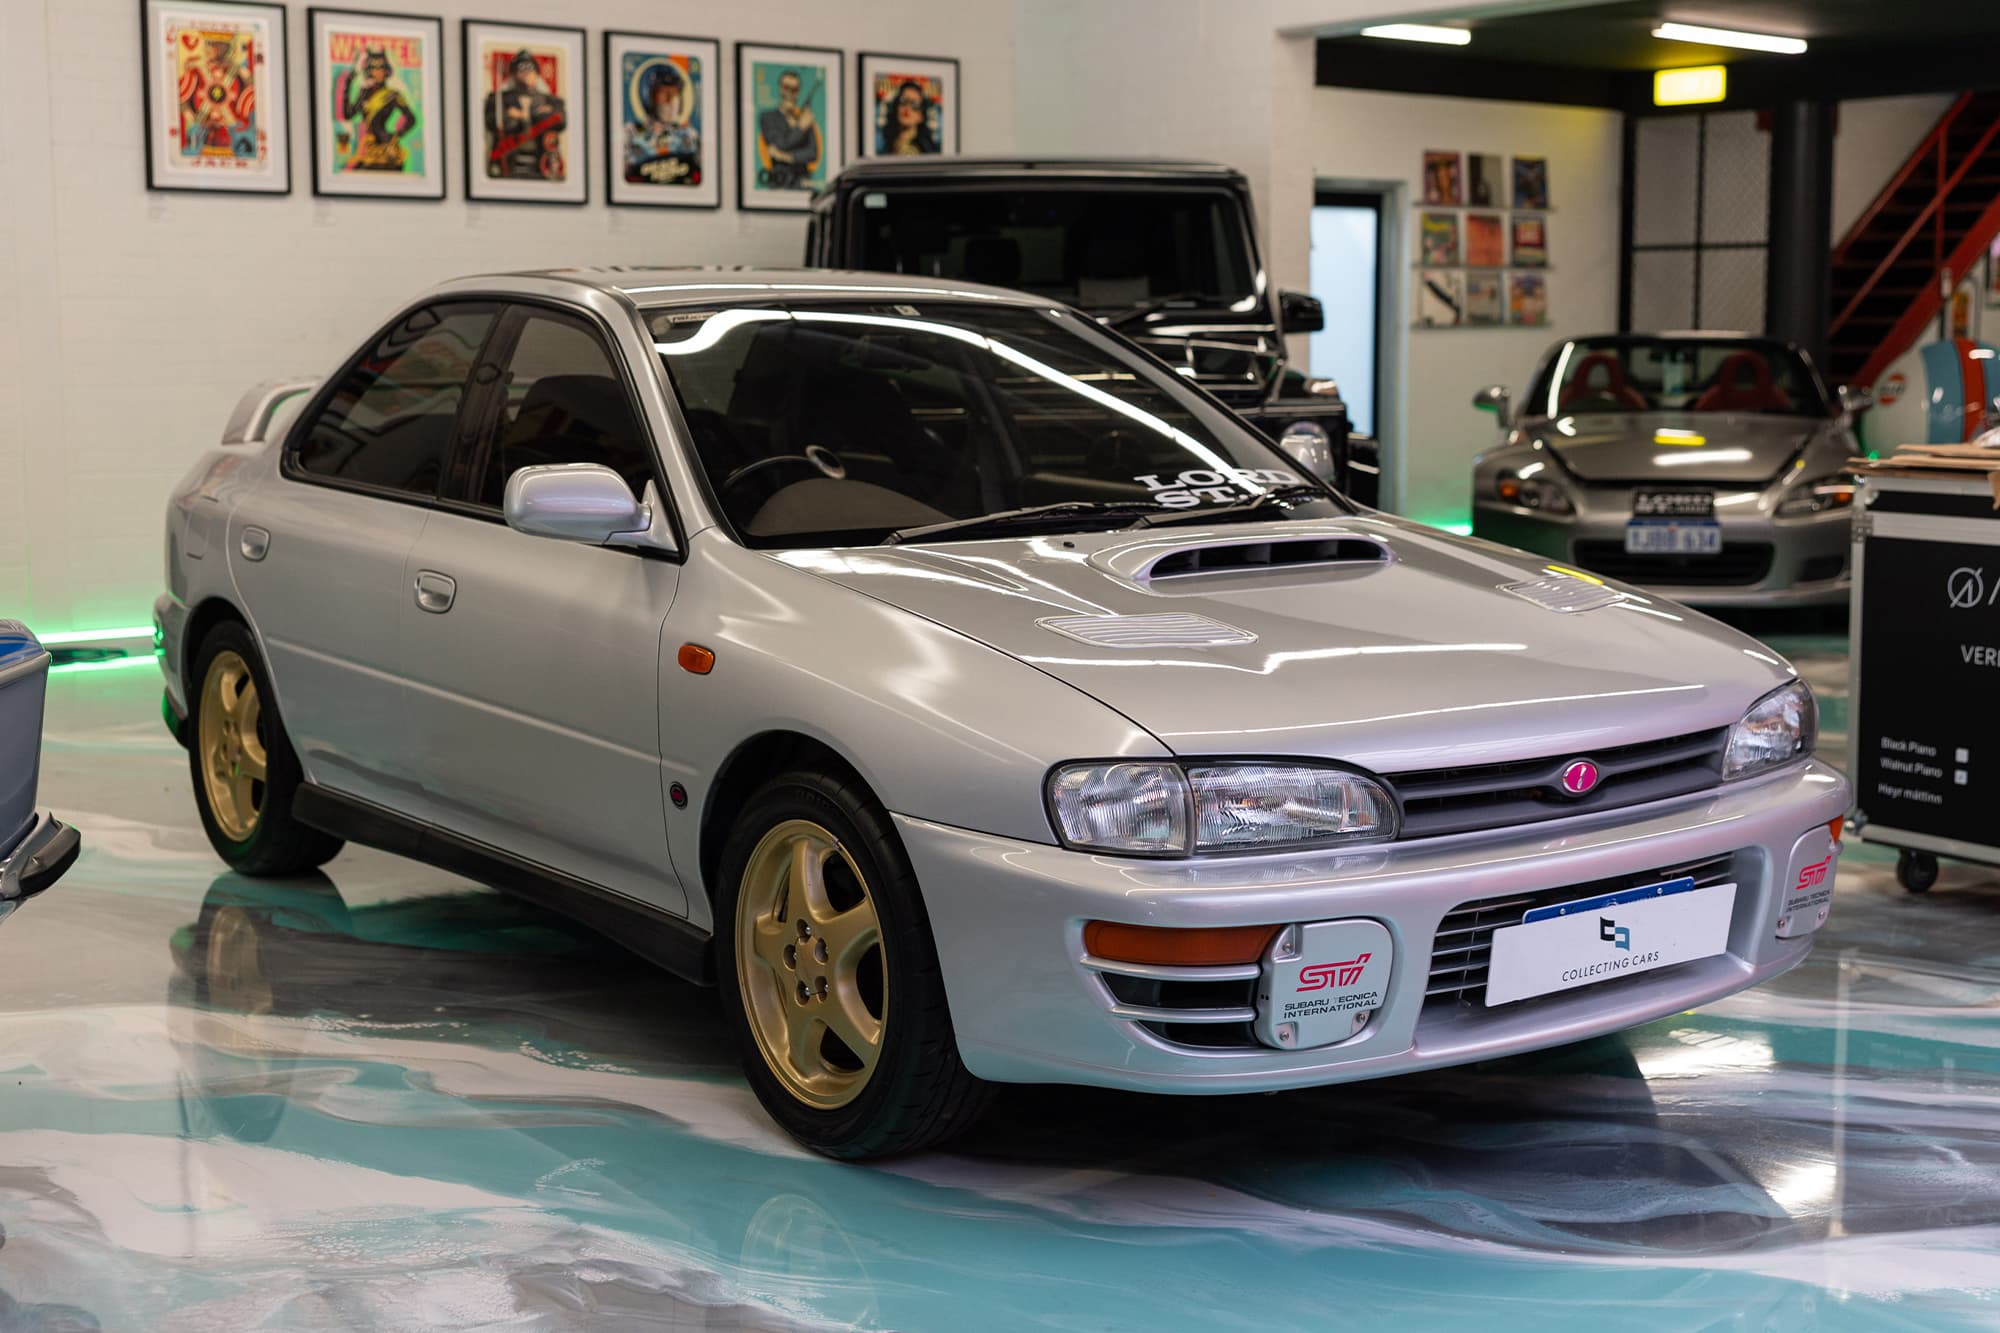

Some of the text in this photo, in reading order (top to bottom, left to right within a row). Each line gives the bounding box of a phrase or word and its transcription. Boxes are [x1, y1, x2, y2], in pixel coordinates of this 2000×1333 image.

[1133, 469, 1302, 491] LORD
[1881, 736, 1937, 757] Black Piano
[1880, 757, 1943, 778] Walnut Piano
[1562, 951, 1659, 982] COLLECTING CARS
[1283, 999, 1378, 1019] INTERNATIONAL
[1284, 998, 1330, 1011] SUBARU
